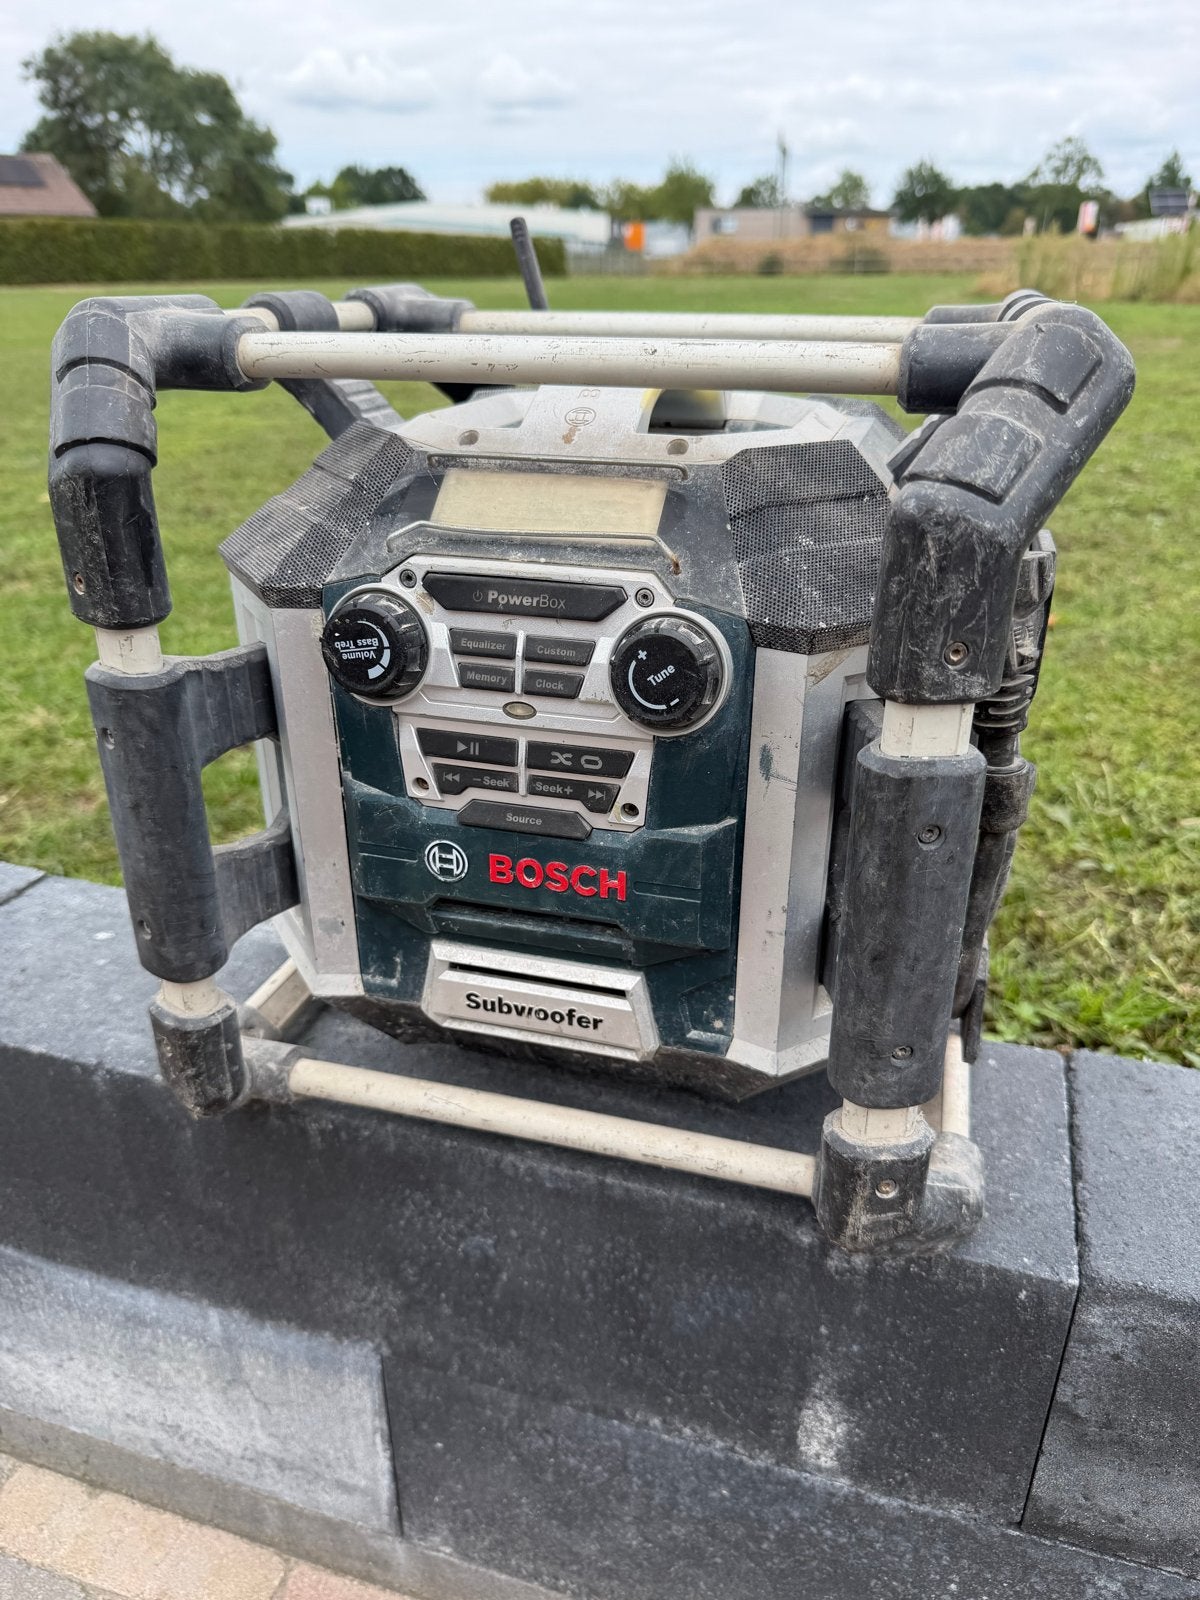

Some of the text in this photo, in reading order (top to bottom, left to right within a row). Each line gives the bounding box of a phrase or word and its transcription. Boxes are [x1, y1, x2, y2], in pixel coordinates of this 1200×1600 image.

[488, 590, 566, 609] PowerBox
[335, 637, 379, 649] Bass Treb
[461, 637, 506, 652] Equalizer
[342, 650, 376, 660] Volume
[537, 645, 576, 658] Custom
[466, 670, 507, 686] Memory
[647, 664, 676, 686] Tune
[535, 678, 564, 691] Clock
[506, 813, 542, 826] Source
[489, 853, 627, 901] BOSCH
[466, 992, 603, 1030] Subwoofer
